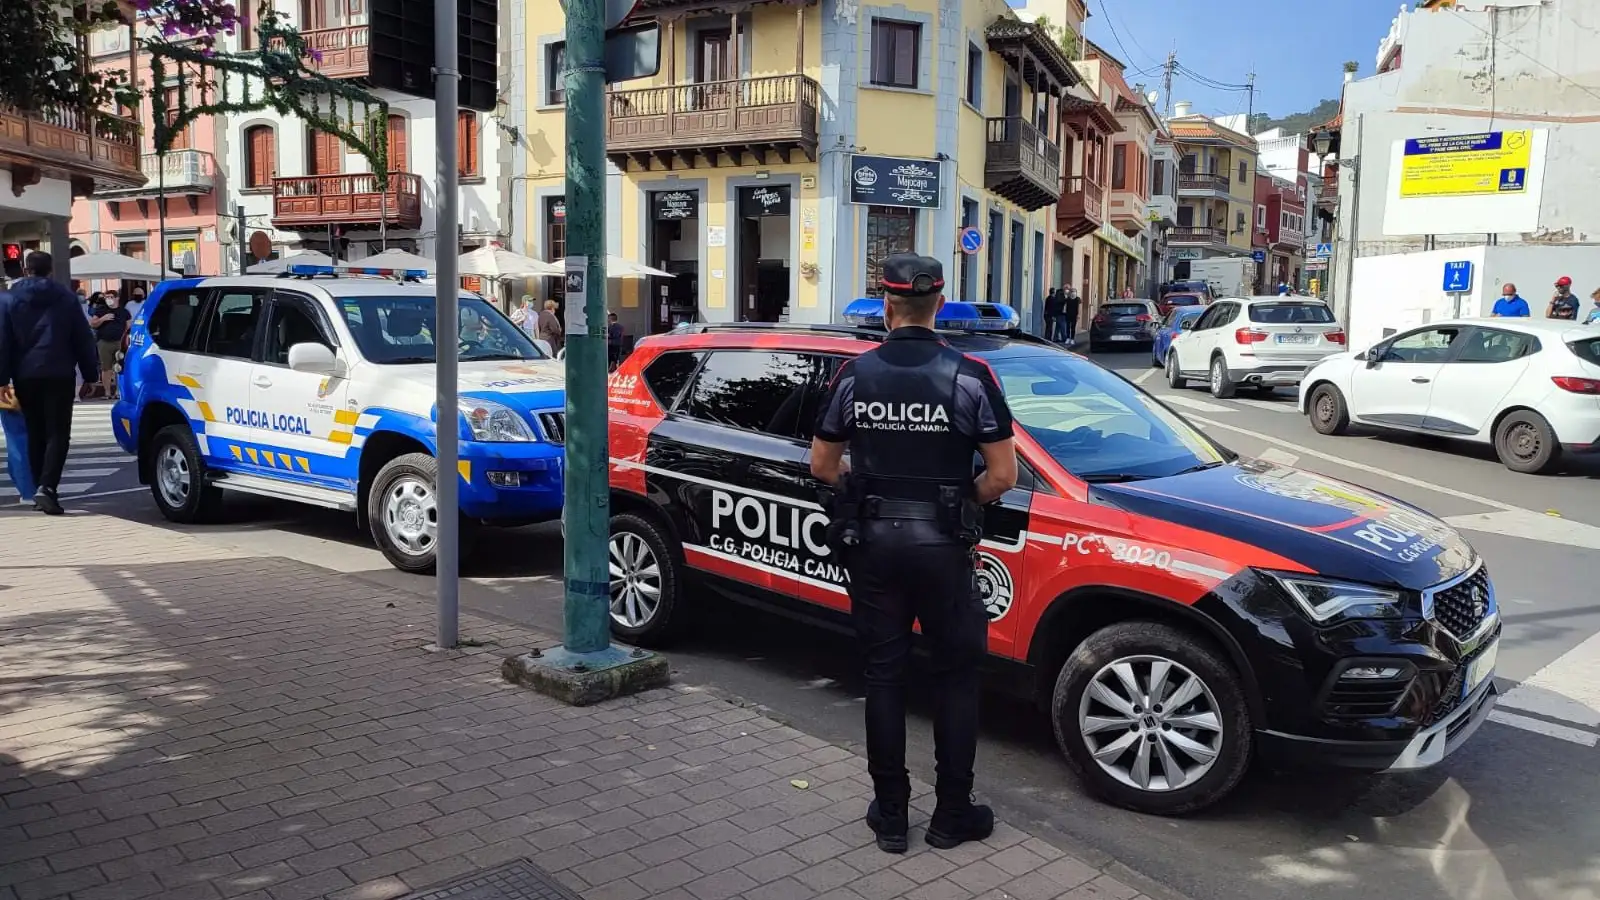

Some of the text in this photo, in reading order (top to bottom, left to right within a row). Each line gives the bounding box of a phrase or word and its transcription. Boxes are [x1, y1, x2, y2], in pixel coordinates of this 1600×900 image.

[226, 406, 311, 435] POLICIA LOCAL
[854, 401, 950, 423] POLICIA
[856, 421, 871, 429] C.G.
[908, 424, 950, 432] CANARIA
[712, 489, 832, 557] POLIC
[709, 533, 737, 555] C.G.
[804, 558, 851, 584] CANA
